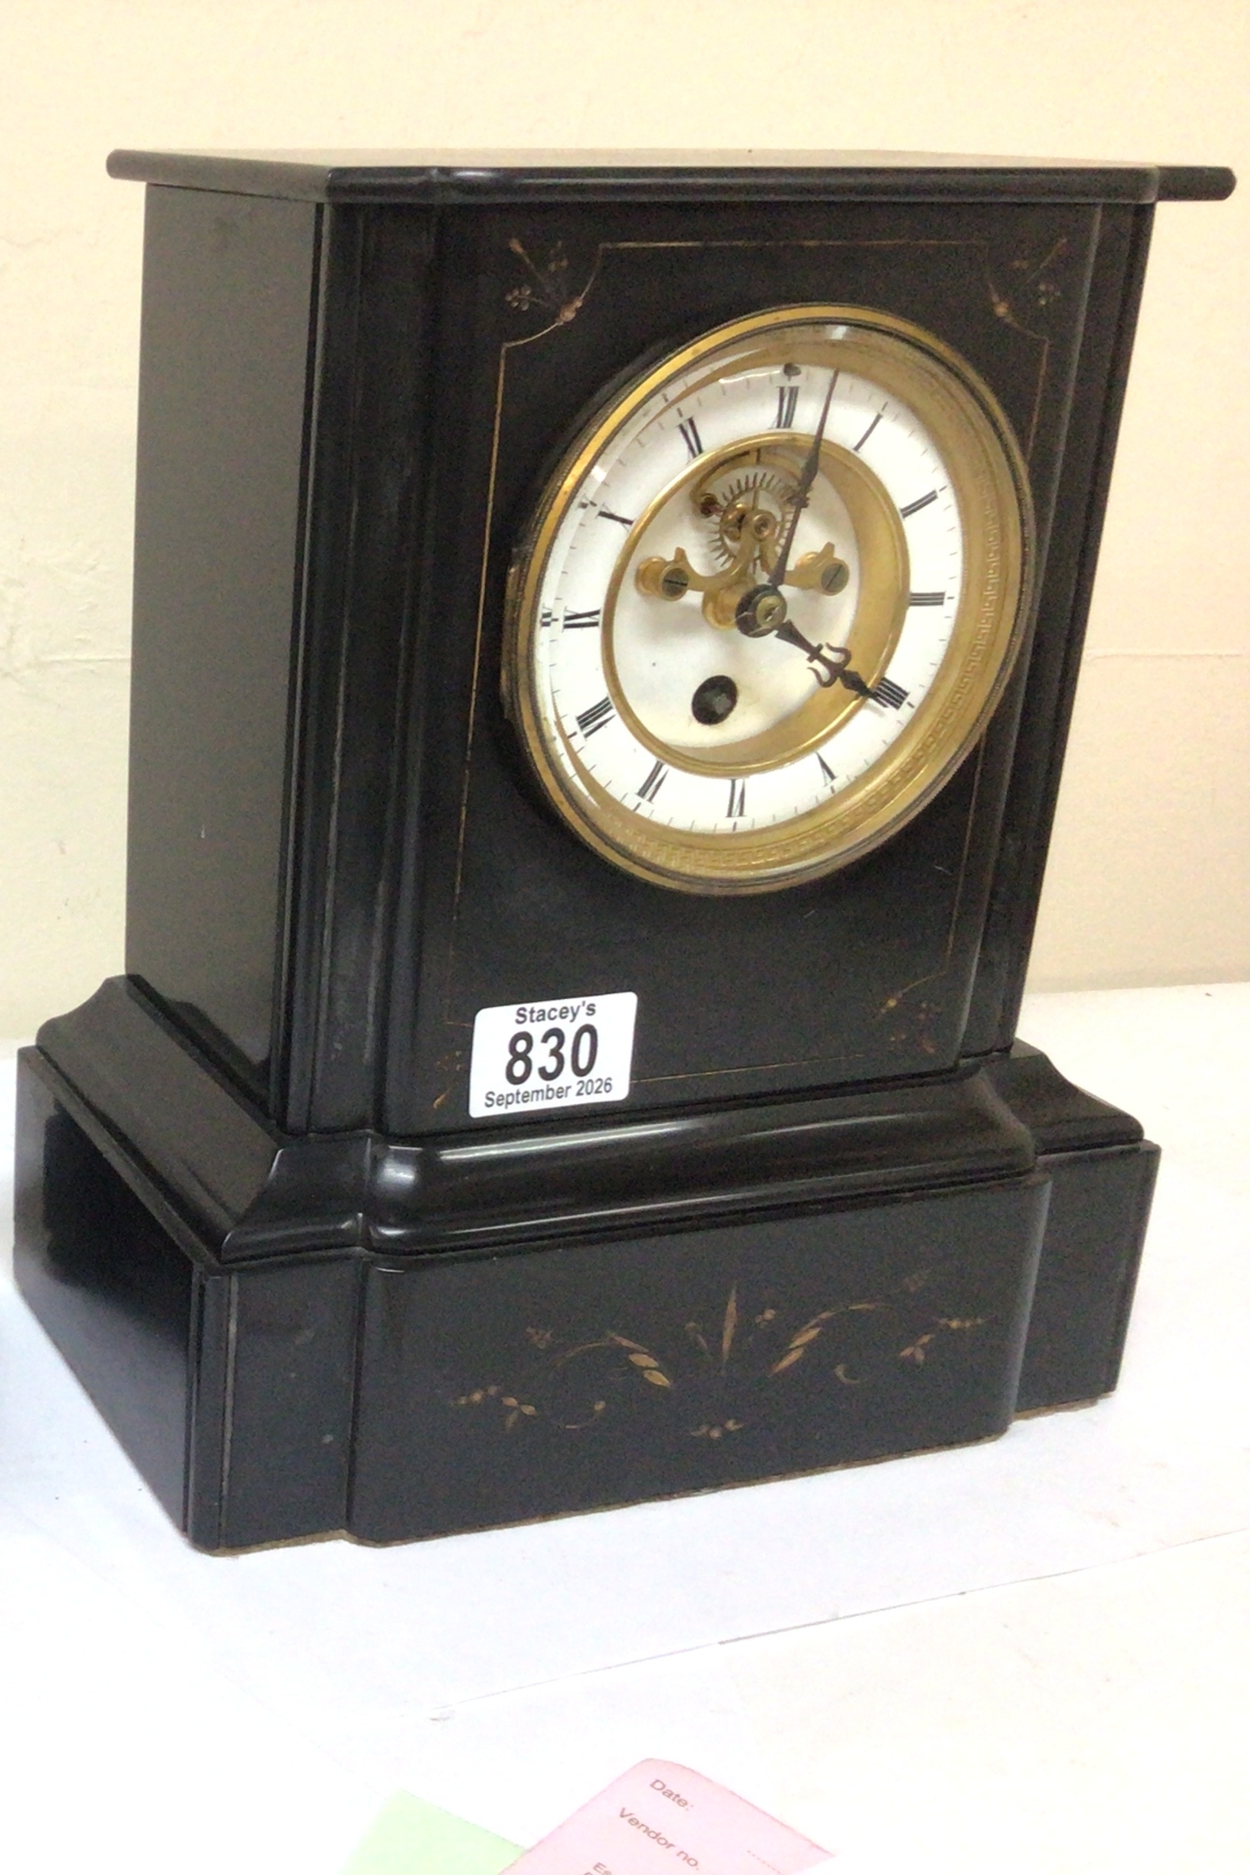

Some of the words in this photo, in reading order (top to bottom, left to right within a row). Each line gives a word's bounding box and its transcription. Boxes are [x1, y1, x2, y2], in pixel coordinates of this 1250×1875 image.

[767, 385, 801, 430] XII
[853, 412, 882, 453] I
[595, 502, 636, 534] X
[899, 489, 938, 520] II
[561, 606, 602, 633] IX
[815, 751, 837, 788] V
[725, 778, 747, 818] VI
[515, 1000, 597, 1025] Stacey's
[505, 1023, 598, 1086] 830
[484, 1084, 572, 1109] September
[575, 1077, 613, 1097] 2026
[650, 1779, 694, 1811] Date:
[619, 1807, 676, 1849] Vendor
[676, 1850, 700, 1871] no.
